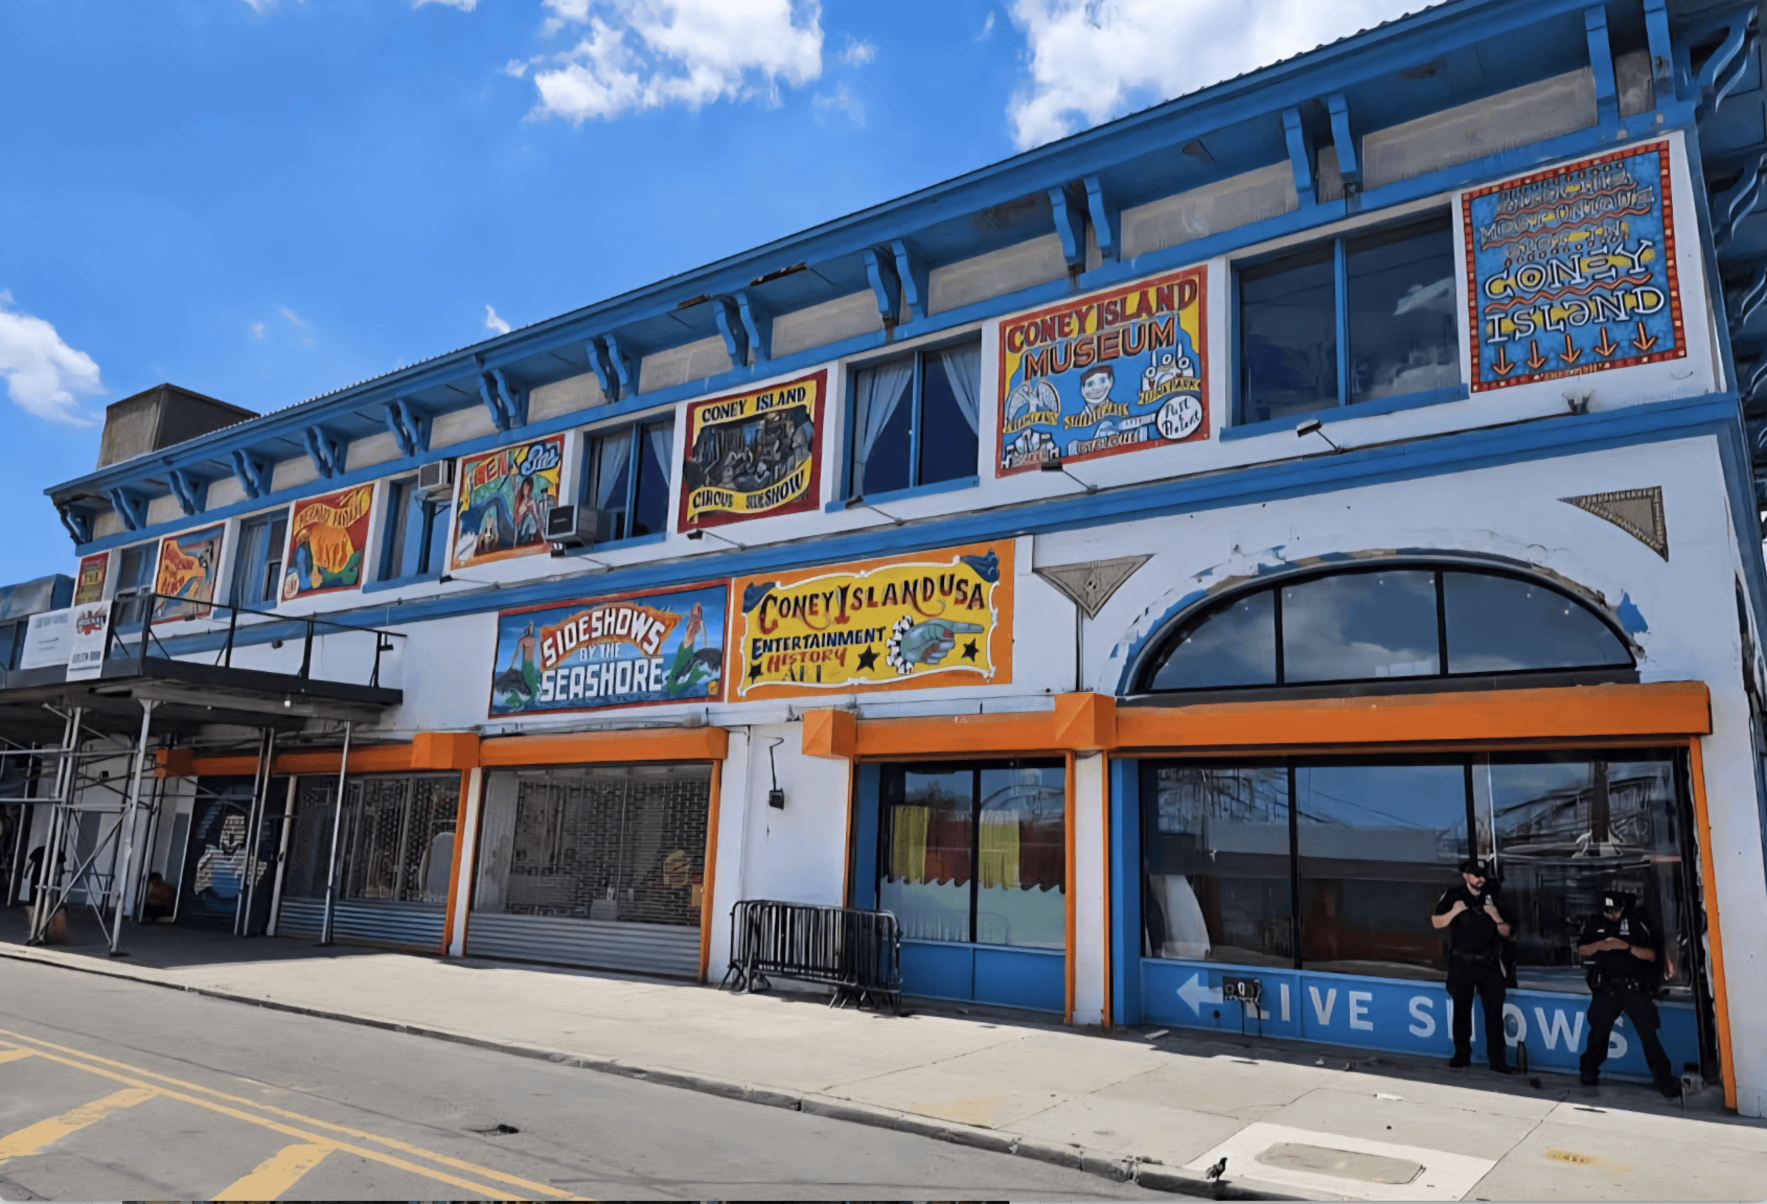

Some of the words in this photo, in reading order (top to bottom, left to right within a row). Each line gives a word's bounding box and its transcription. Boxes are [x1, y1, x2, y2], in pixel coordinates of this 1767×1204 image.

[1006, 305, 1095, 354] CONEY
[1096, 278, 1199, 331] ISLAND
[1024, 316, 1176, 381] MUSEUM
[701, 399, 747, 423] CONEY
[755, 386, 807, 412] ISLAND
[745, 467, 805, 509] SSHOW
[757, 589, 835, 635] CONEY
[833, 575, 946, 625] ISLAND
[938, 573, 986, 611] USA
[542, 606, 666, 668] SIDESHOWS
[579, 644, 597, 662] BY
[598, 642, 620, 659] THE
[751, 626, 887, 661] ENTERTAINMENT
[540, 657, 665, 702] SEASHORE
[766, 646, 848, 674] HISTORY
[1408, 995, 1629, 1059] SOWS
